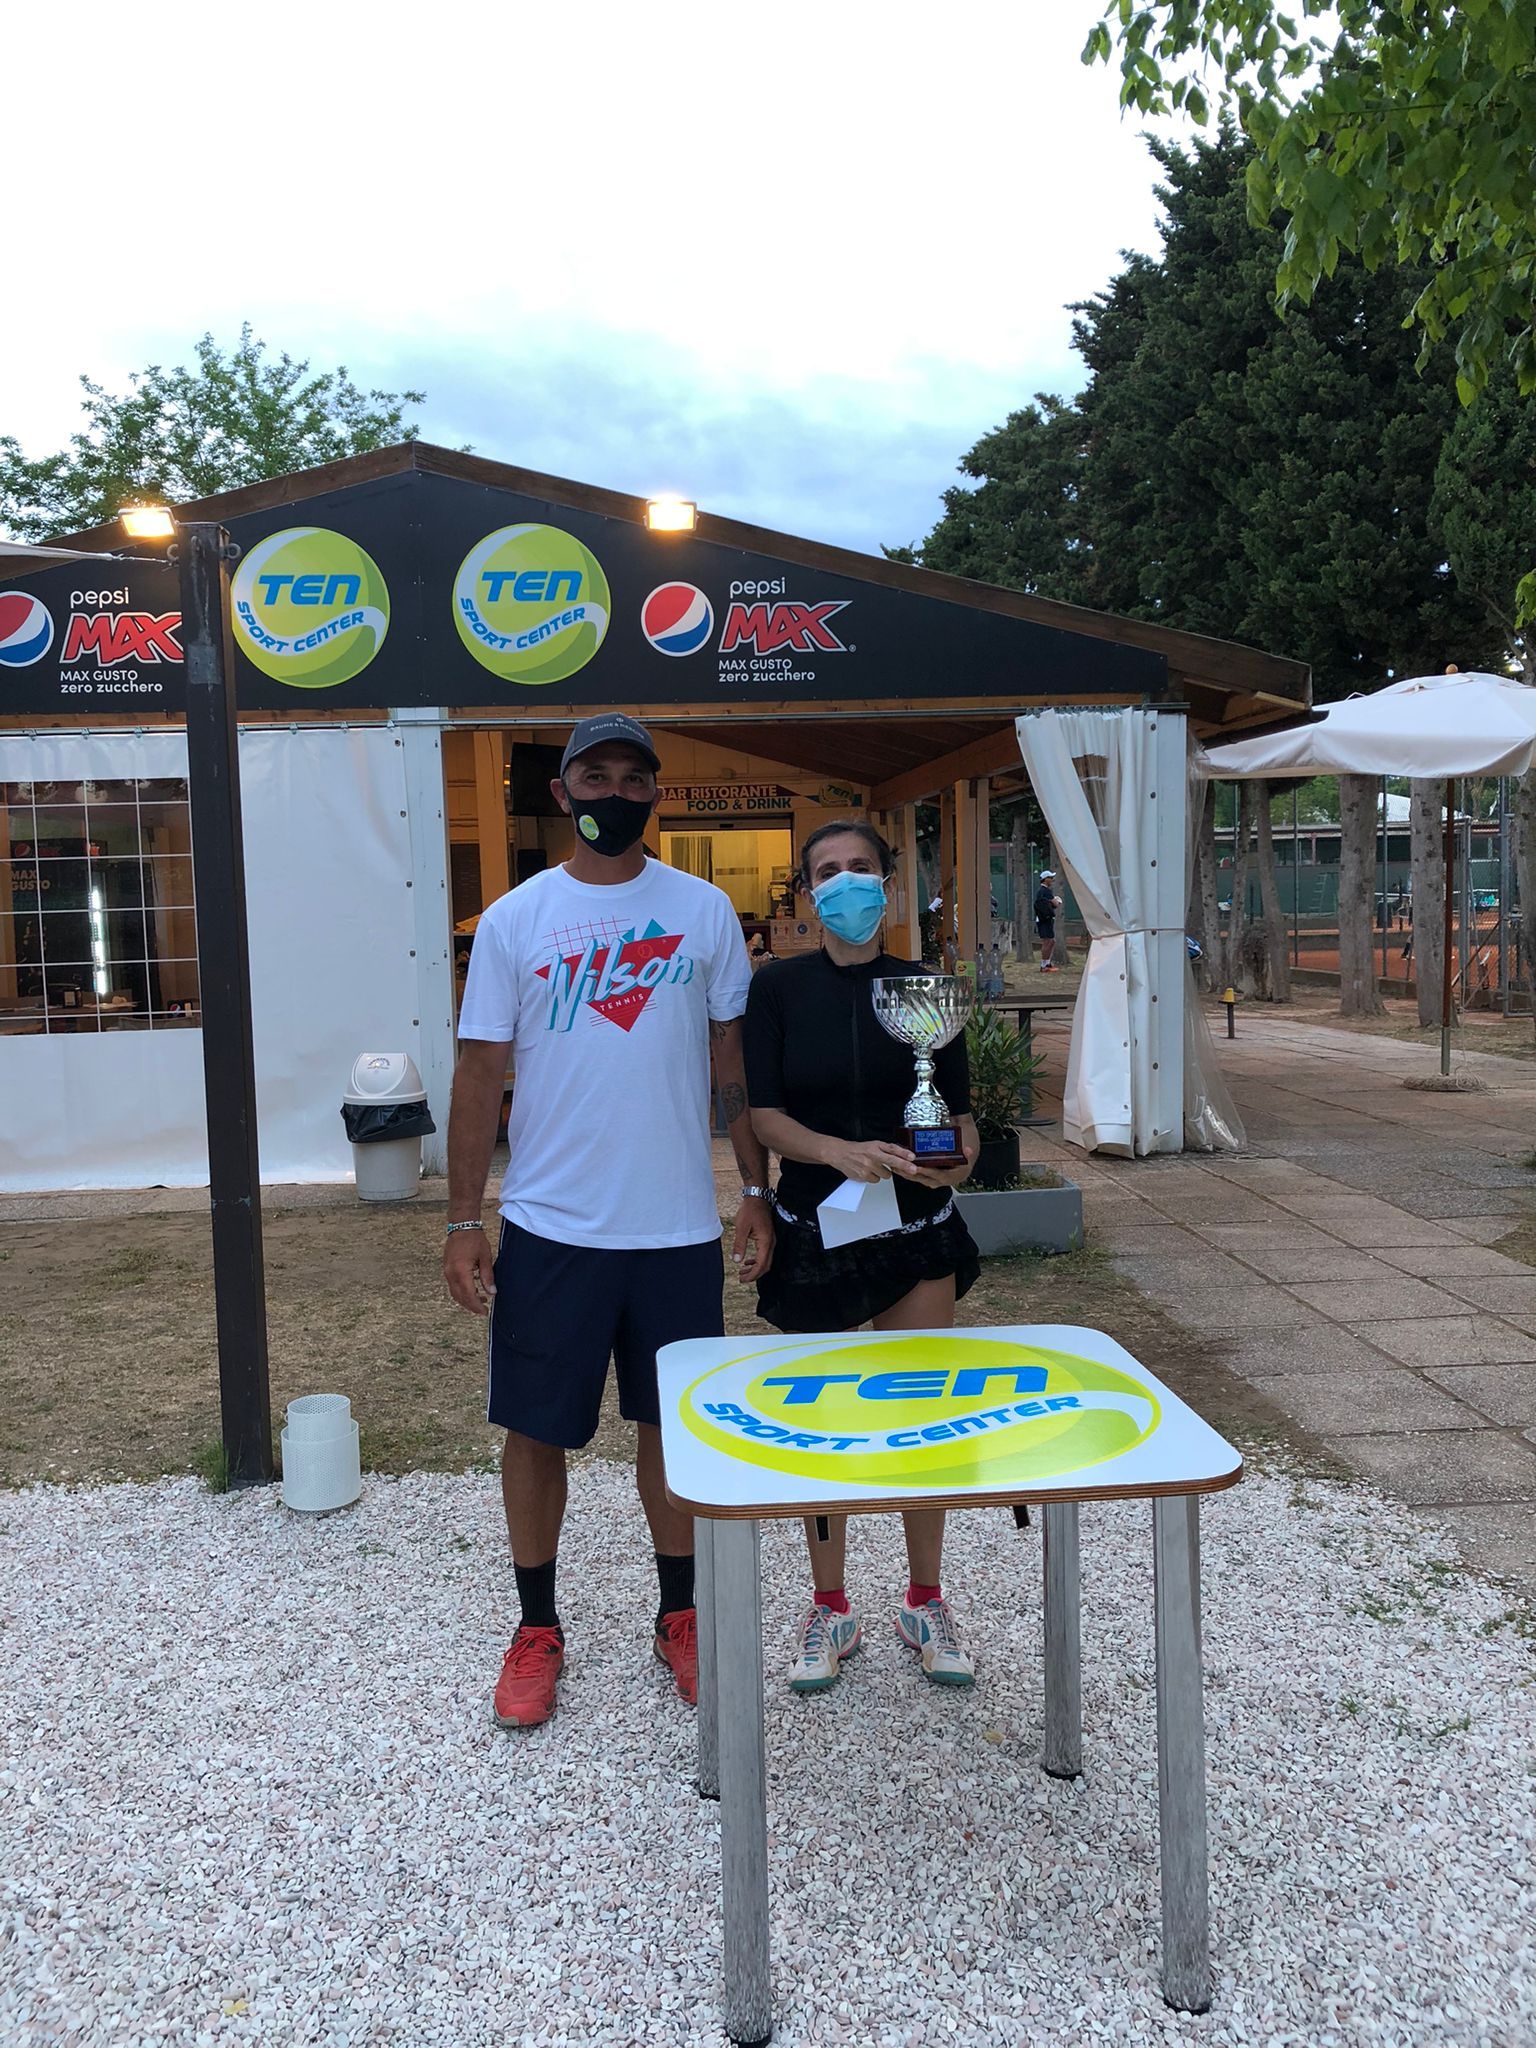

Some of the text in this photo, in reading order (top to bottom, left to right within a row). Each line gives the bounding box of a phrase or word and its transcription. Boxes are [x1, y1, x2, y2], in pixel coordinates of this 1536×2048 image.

[70, 587, 129, 609] pepsi
[729, 577, 786, 599] pepsi
[237, 601, 364, 654] SPORT CENTER
[460, 597, 586, 650] SPORT CENTER
[718, 600, 853, 656] MAX
[59, 611, 184, 667] MAX
[60, 670, 138, 681] MAX GUSTO
[718, 659, 792, 671] MAX GUSTO
[718, 669, 816, 683] zero zucchero
[60, 681, 163, 693] zero zucchero
[690, 785, 778, 799] RISTORANTE
[687, 797, 792, 812] FOOD & DRINK
[544, 937, 694, 1032] Wilson
[599, 993, 645, 1012] TENNIS
[702, 1395, 1081, 1451] SPORT CENTER
